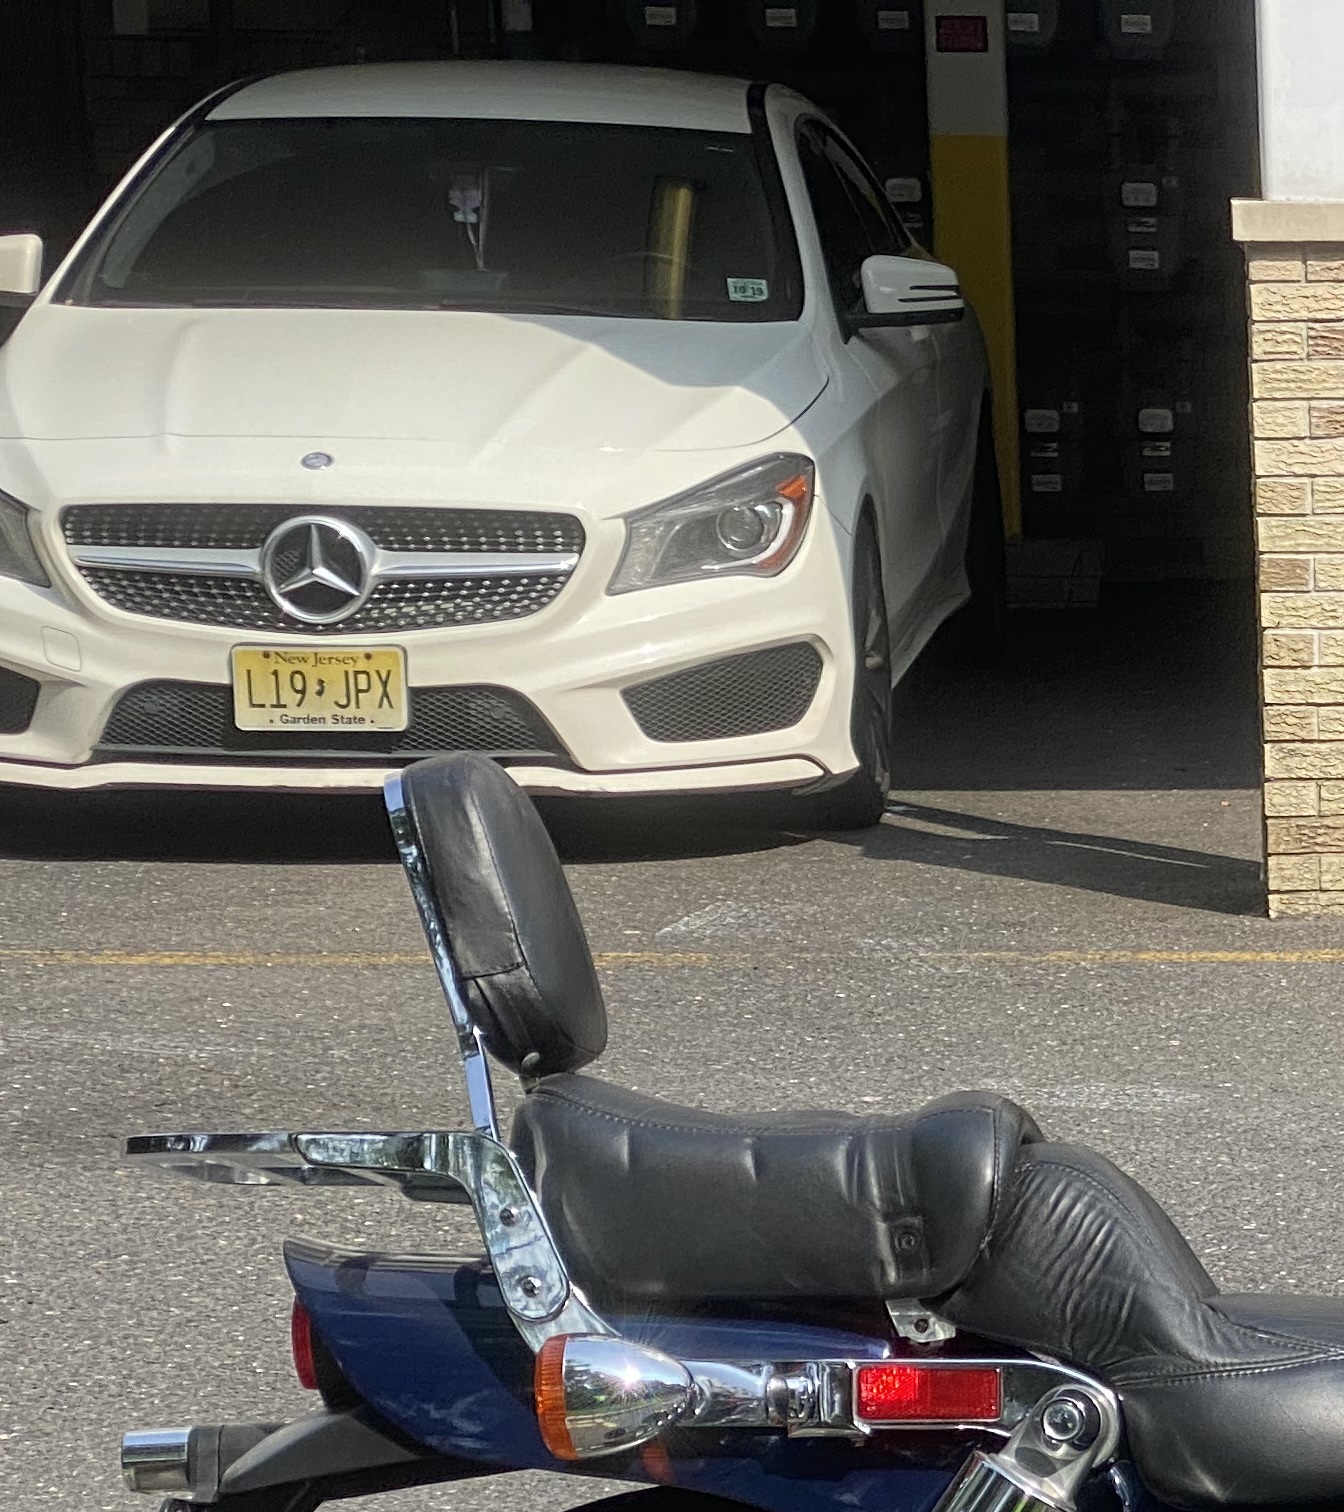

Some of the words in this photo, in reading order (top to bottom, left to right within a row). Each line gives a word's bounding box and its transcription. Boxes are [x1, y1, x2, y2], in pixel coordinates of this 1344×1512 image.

[274, 651, 309, 665] New
[312, 652, 359, 667] Jersey
[246, 669, 308, 709] L19
[333, 669, 394, 709] JPX
[280, 714, 325, 725] Garden
[331, 714, 366, 725] State
